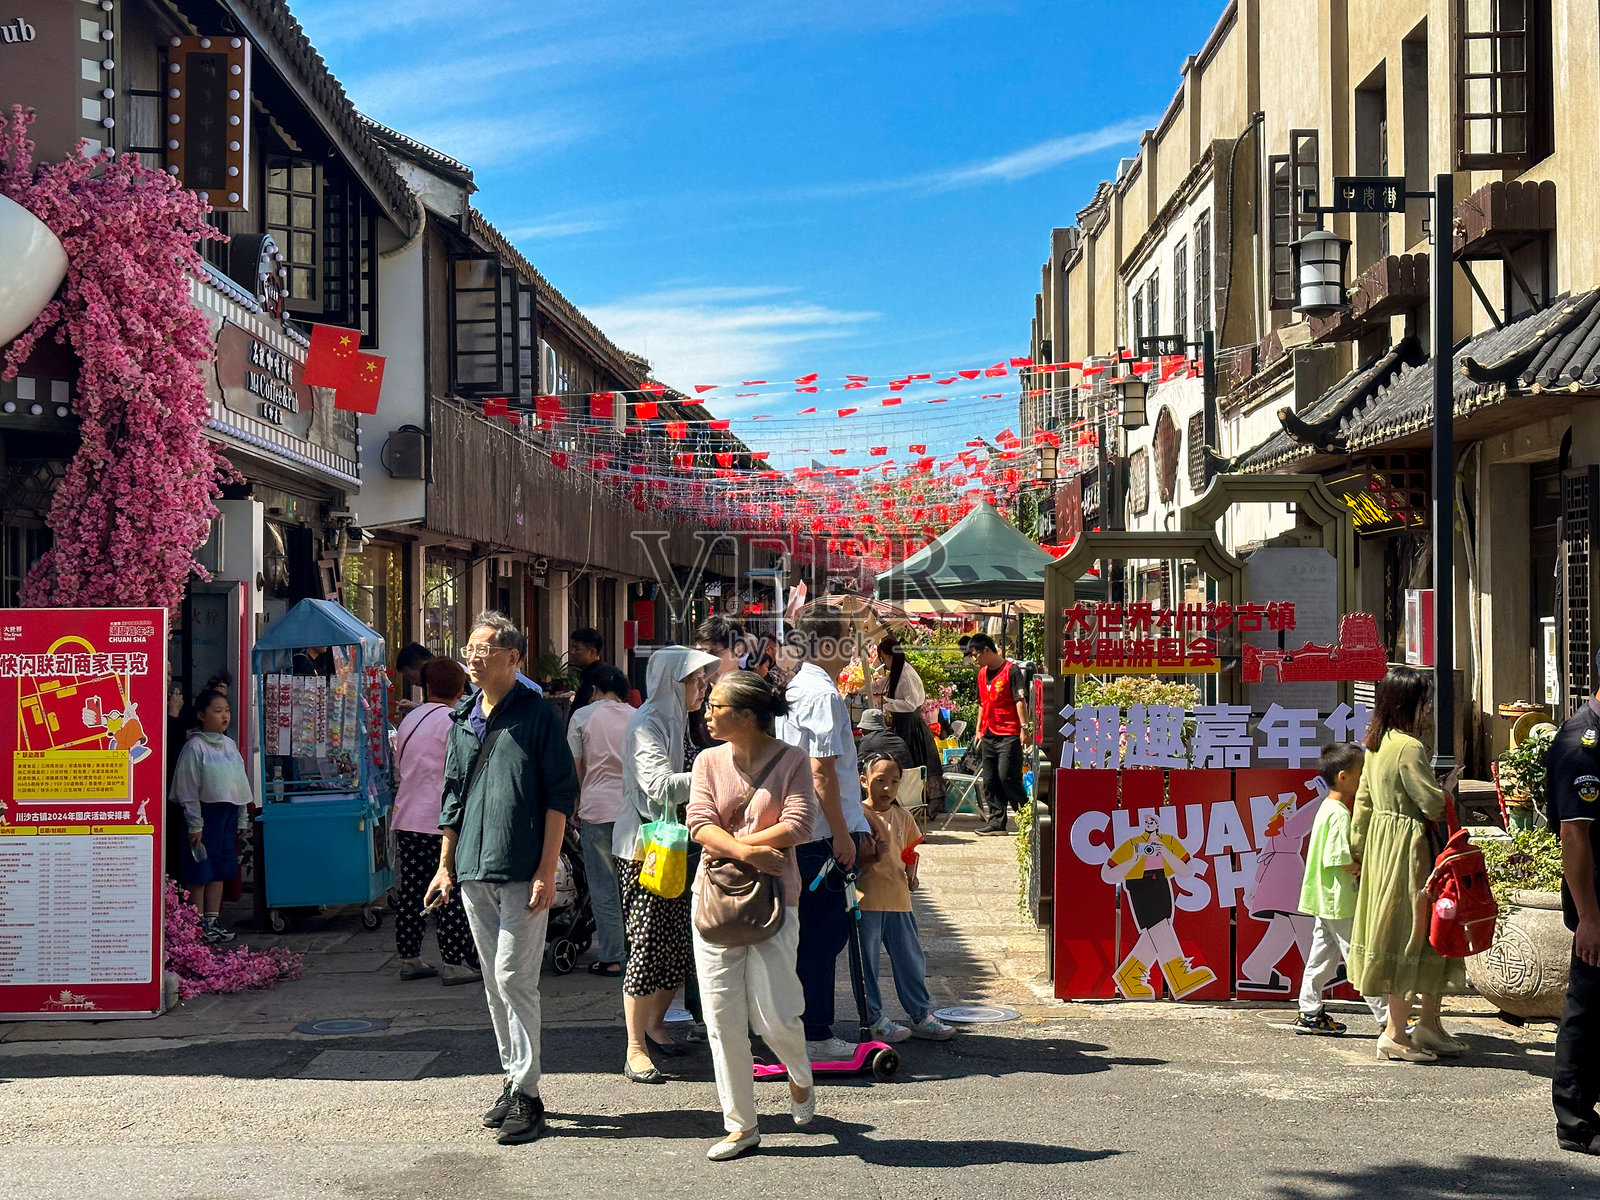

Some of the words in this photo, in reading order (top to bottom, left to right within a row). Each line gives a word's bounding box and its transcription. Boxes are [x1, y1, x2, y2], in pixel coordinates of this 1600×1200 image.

[0, 653, 148, 677] 快闪联动商家导览
[1062, 637, 1218, 668] 戏剧游园会
[15, 810, 131, 822] 川沙古镇2024年国庆活动安排表
[1070, 792, 1298, 865] CHUAN
[1175, 851, 1258, 912] SH
